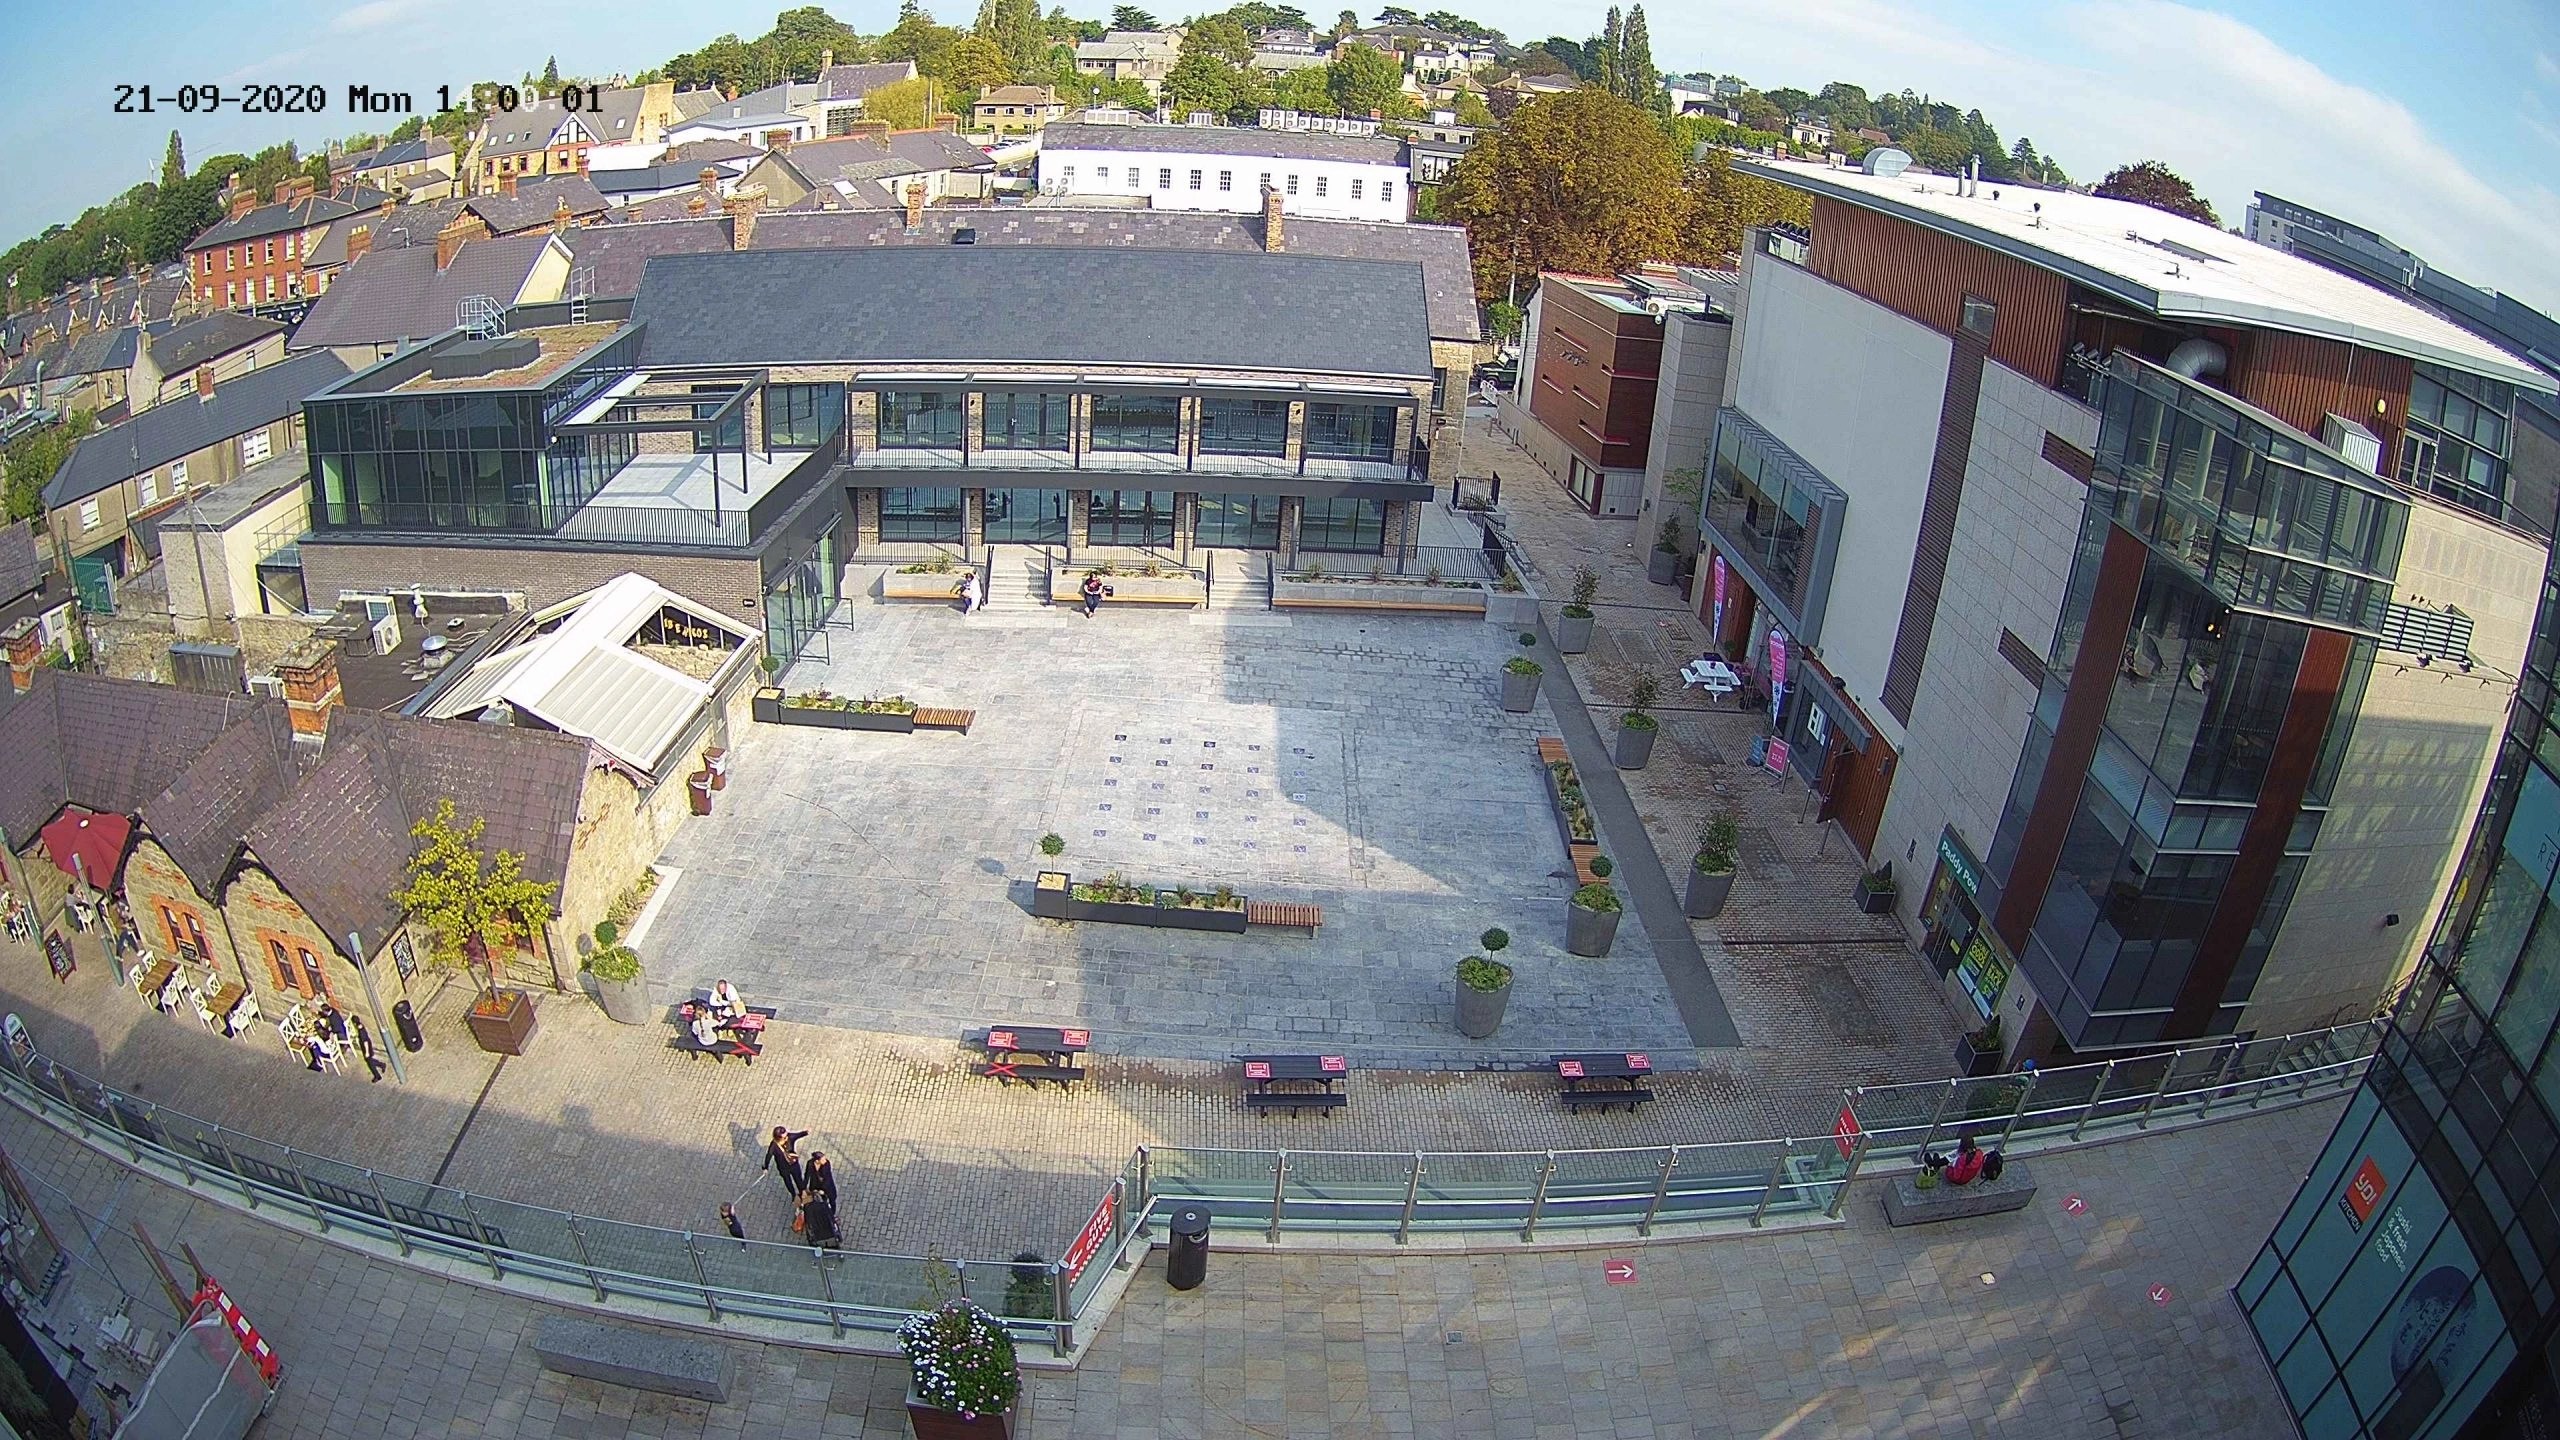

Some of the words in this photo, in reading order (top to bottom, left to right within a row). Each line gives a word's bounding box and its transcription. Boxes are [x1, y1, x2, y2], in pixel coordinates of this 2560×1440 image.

[1941, 840, 1963, 875] Paddy
[1086, 1211, 1110, 1250] GUYS
[1089, 1204, 1108, 1237] FIVE
[2340, 1197, 2361, 1231] KITCHEN
[2395, 1207, 2412, 1235] Sushi
[2375, 1238, 2389, 1263] food
[2381, 1230, 2407, 1273] Japanese
[2387, 1217, 2396, 1230] &
[2392, 1224, 2408, 1253] fresh
